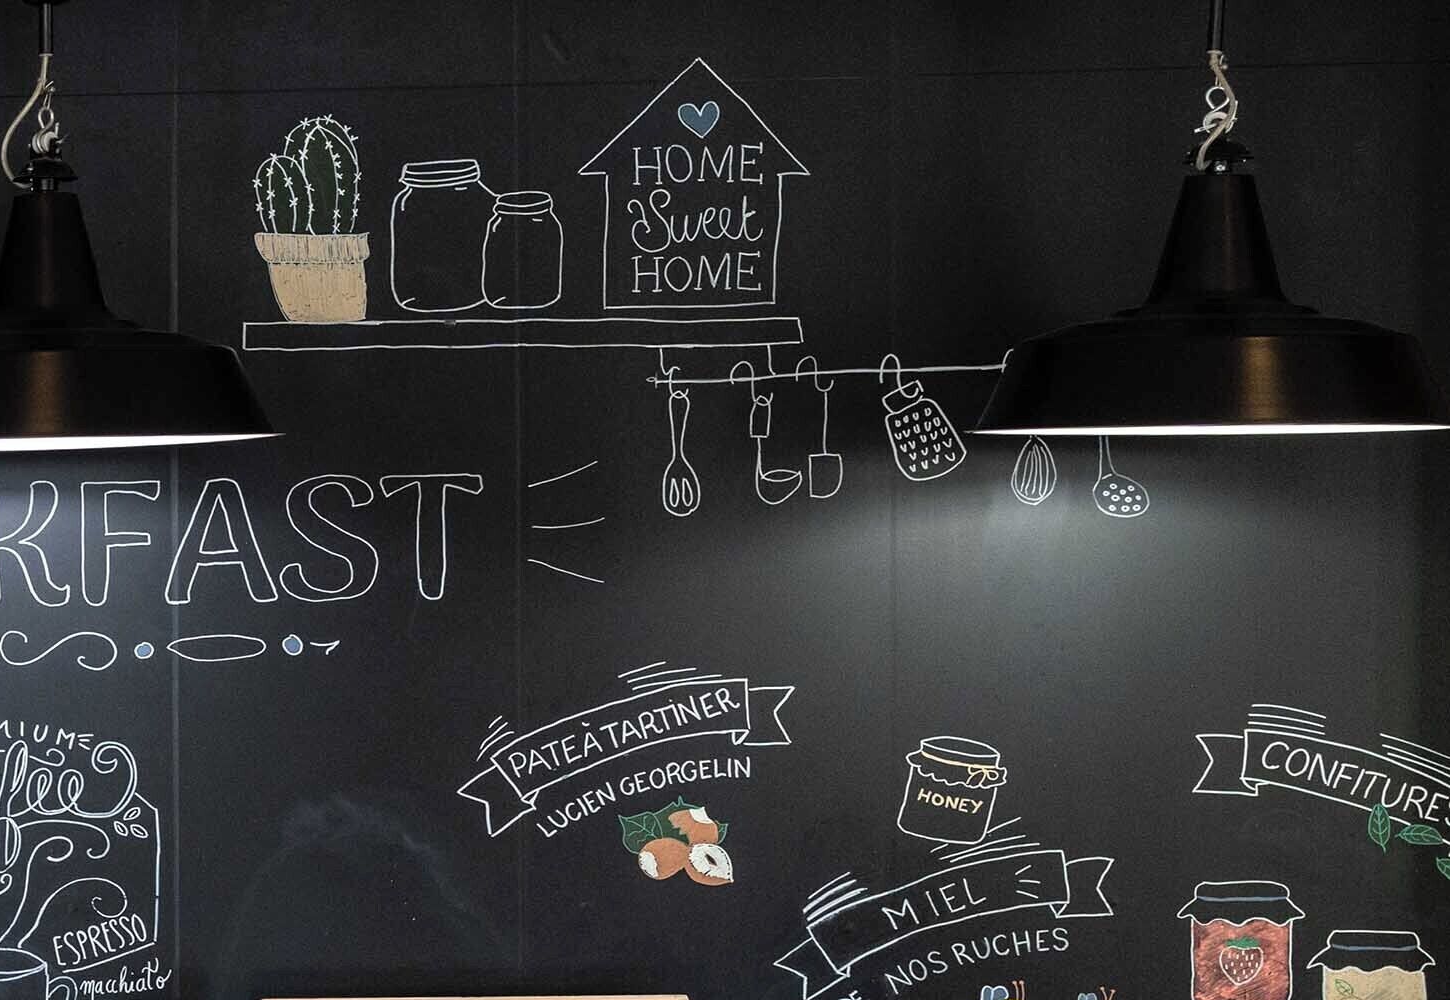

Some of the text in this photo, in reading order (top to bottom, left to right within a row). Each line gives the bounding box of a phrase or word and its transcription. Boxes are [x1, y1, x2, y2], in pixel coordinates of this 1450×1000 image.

[632, 142, 763, 186] HOME
[627, 188, 763, 253] Sweet
[631, 250, 761, 293] HOME
[600, 687, 741, 749] TARTINER
[537, 756, 751, 838] LUCIEN GEORGELIN
[917, 788, 983, 814] HONEY
[1261, 741, 1450, 827] CONFITURE
[882, 878, 986, 930] MIEL
[52, 913, 147, 966] ESPRESSO
[885, 951, 949, 995] NOS
[951, 927, 1070, 965] RUCHES
